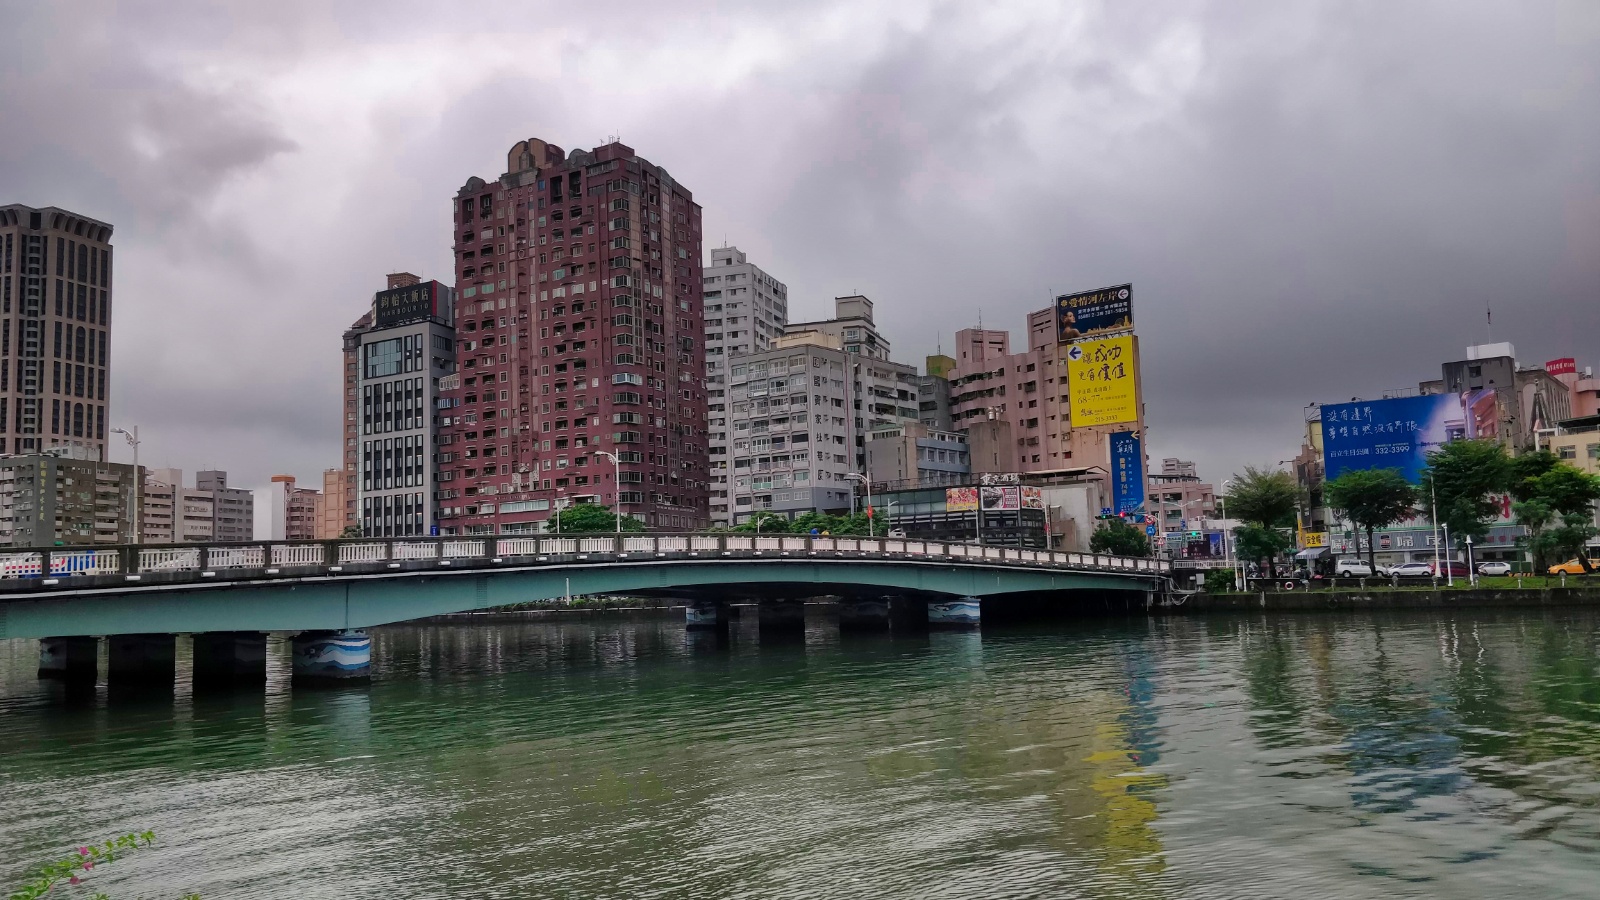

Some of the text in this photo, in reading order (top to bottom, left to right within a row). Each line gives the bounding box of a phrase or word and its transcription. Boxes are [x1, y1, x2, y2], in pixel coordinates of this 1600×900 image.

[380, 288, 429, 309] 鈞怡大飯店
[381, 305, 417, 317] HARBOUR
[1326, 406, 1373, 423] 沒有邊界
[1375, 445, 1410, 455] 332-3399
[980, 472, 1021, 485] 東京酒場
